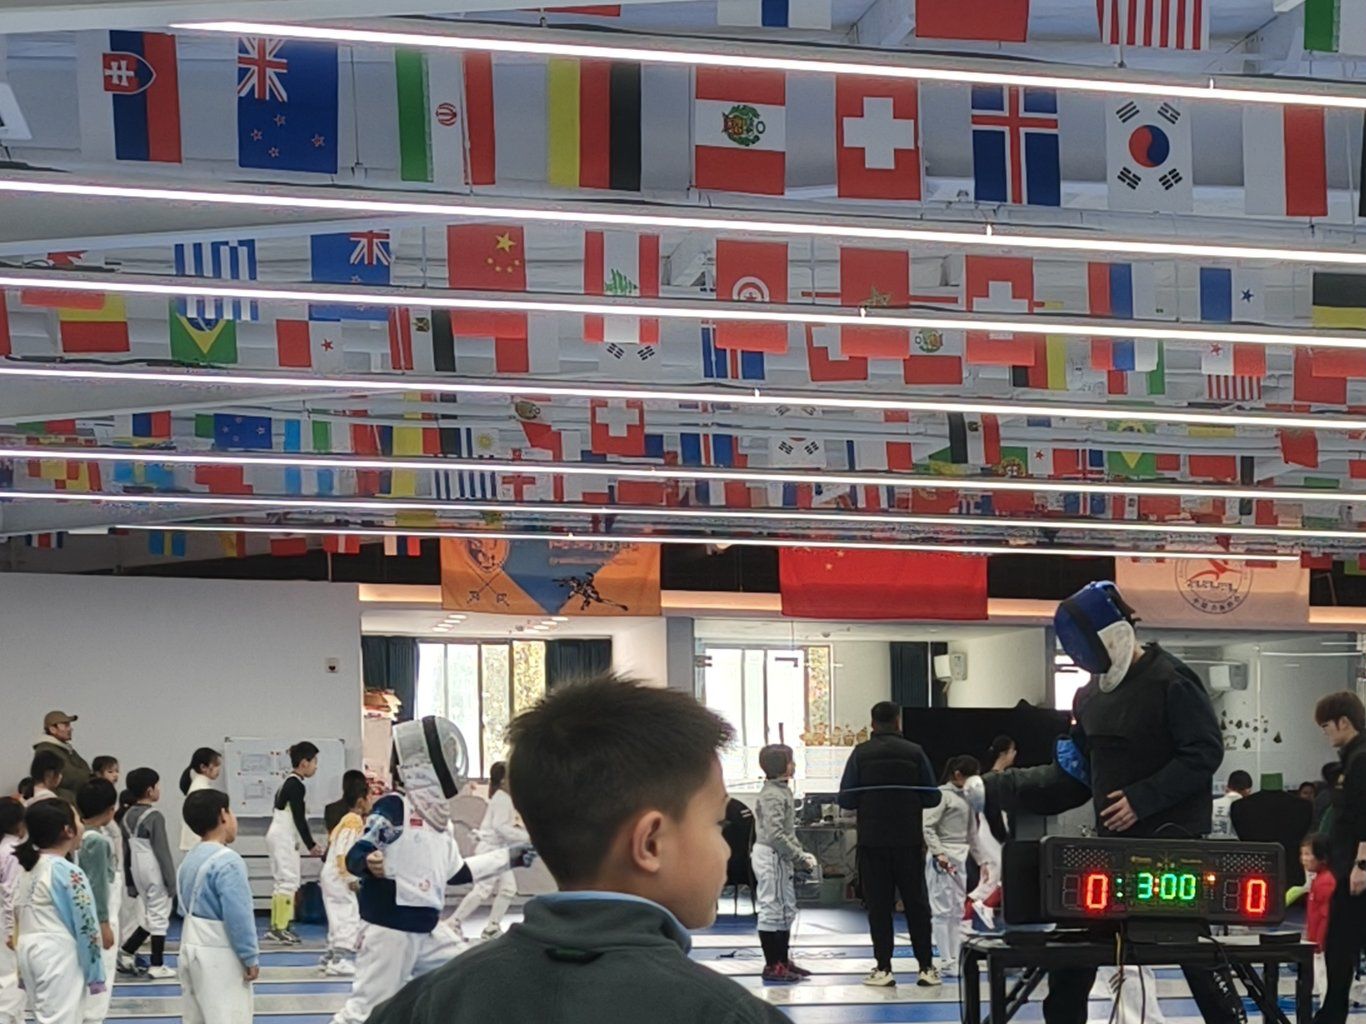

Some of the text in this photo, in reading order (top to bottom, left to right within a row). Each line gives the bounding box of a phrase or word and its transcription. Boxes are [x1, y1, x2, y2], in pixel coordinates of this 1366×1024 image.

[1087, 873, 1266, 913] 0 3:00 0
